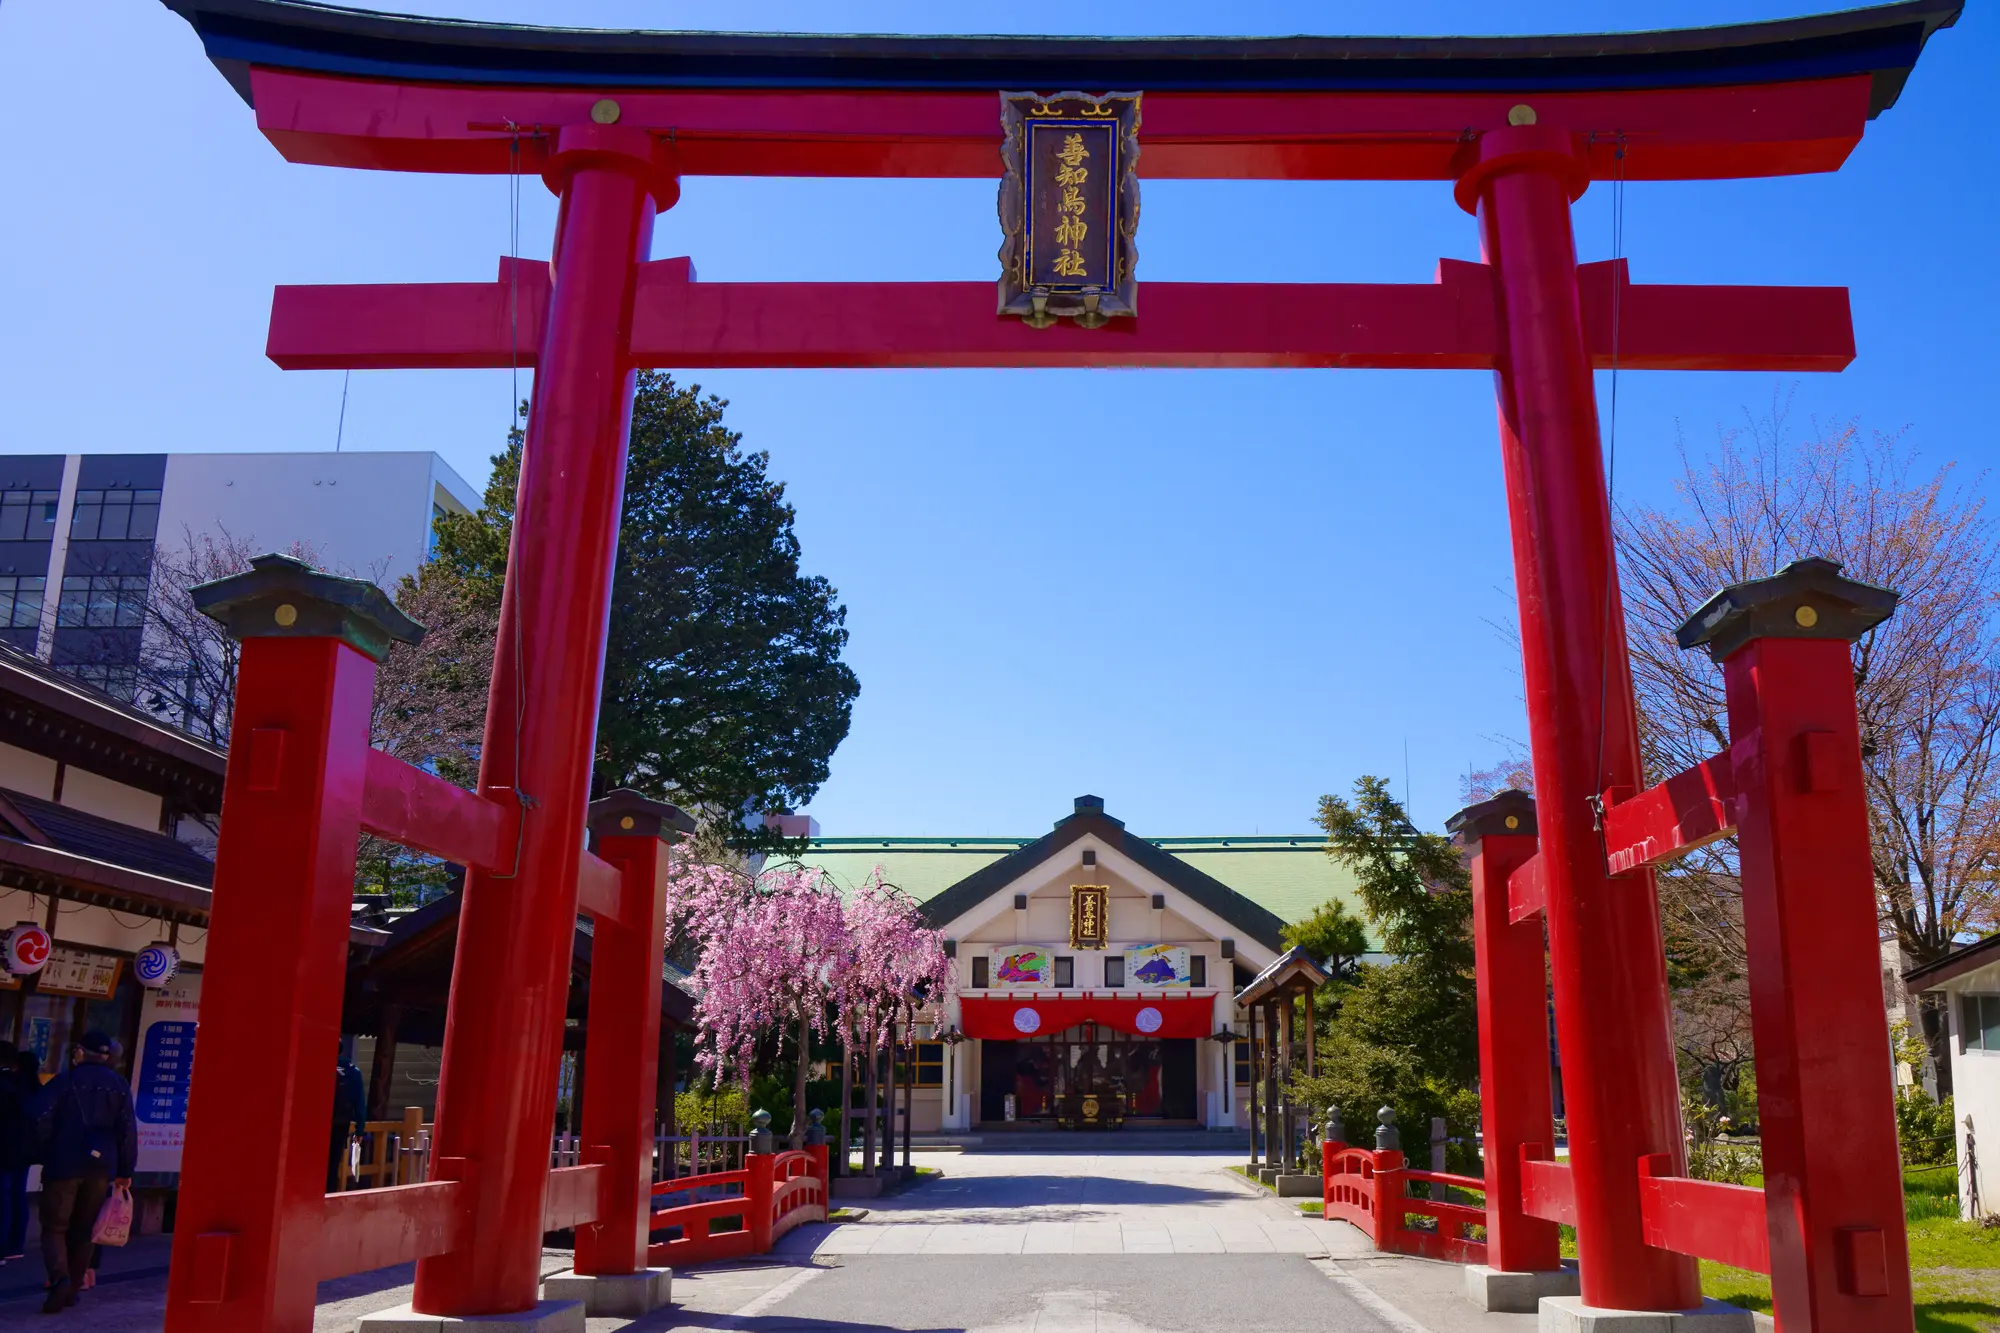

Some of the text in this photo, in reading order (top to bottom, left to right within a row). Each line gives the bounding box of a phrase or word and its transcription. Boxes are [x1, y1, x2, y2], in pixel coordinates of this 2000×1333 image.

[1053, 132, 1090, 277] 善知鳥神社
